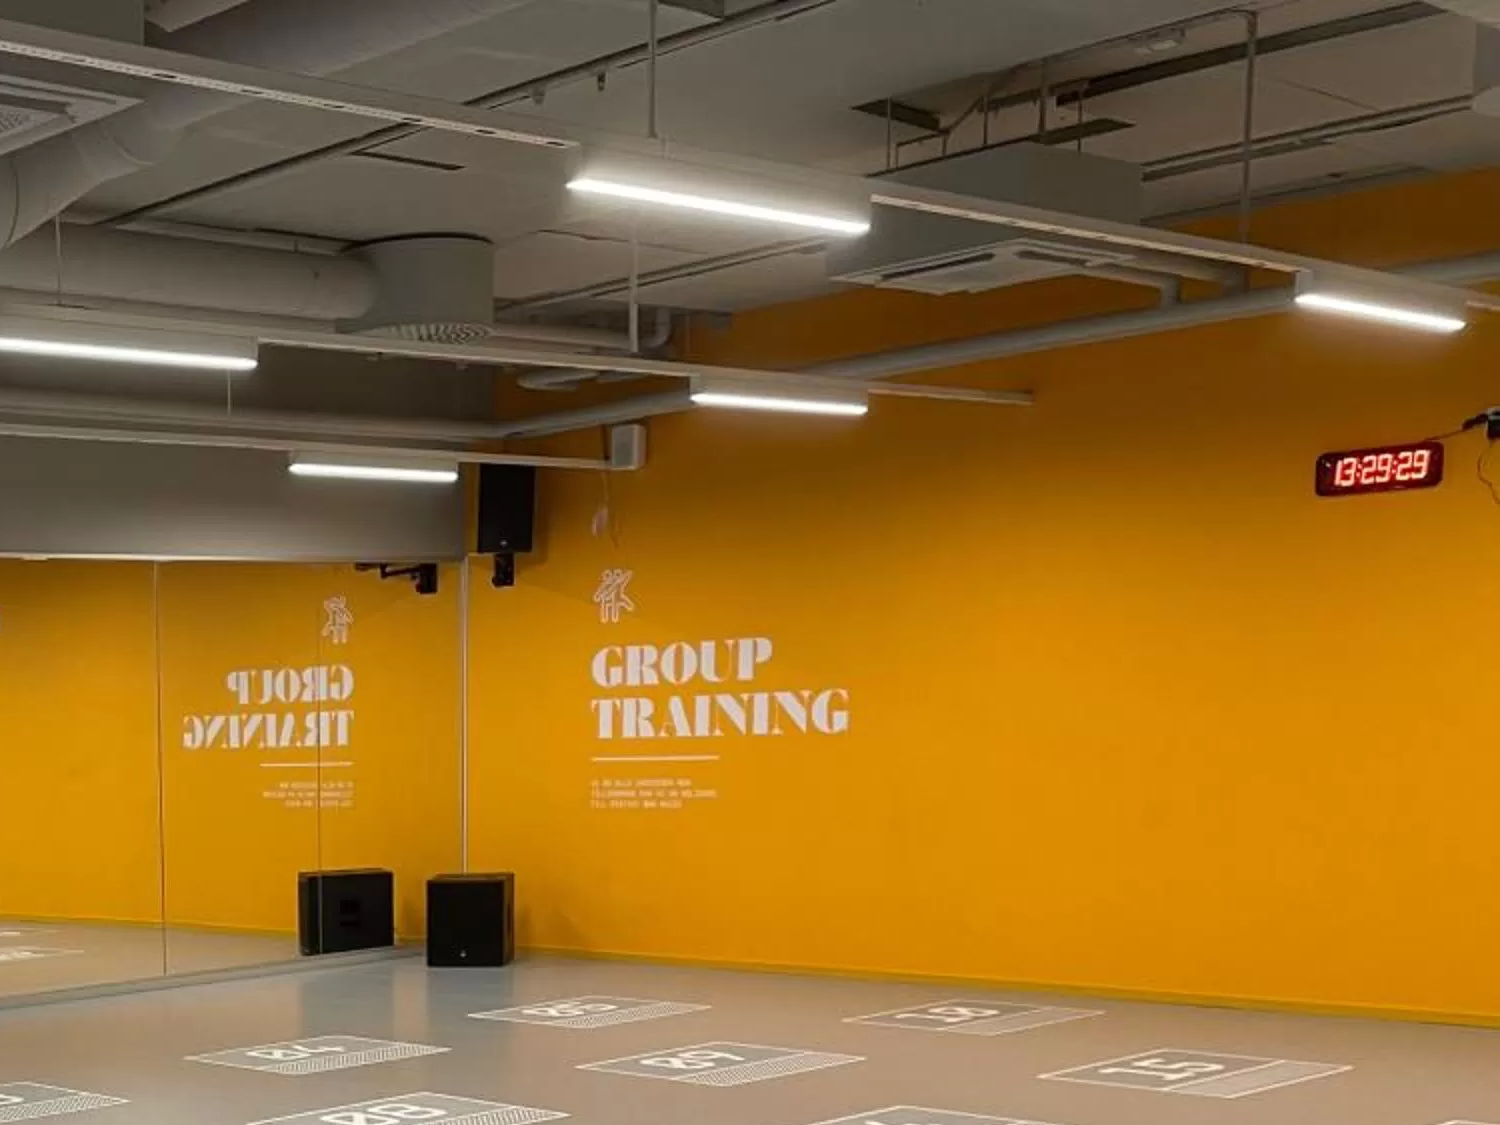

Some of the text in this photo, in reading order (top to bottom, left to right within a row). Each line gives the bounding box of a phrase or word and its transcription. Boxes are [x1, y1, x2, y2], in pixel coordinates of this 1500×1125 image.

[1334, 449, 1431, 487] 13:29:29
[591, 636, 773, 689] GROUP
[591, 688, 849, 740] TRAINING
[521, 1001, 619, 1017] 05
[894, 1005, 1000, 1023] 10
[245, 1044, 345, 1061] 04
[639, 1050, 746, 1070] 09
[1097, 1057, 1225, 1081] 15
